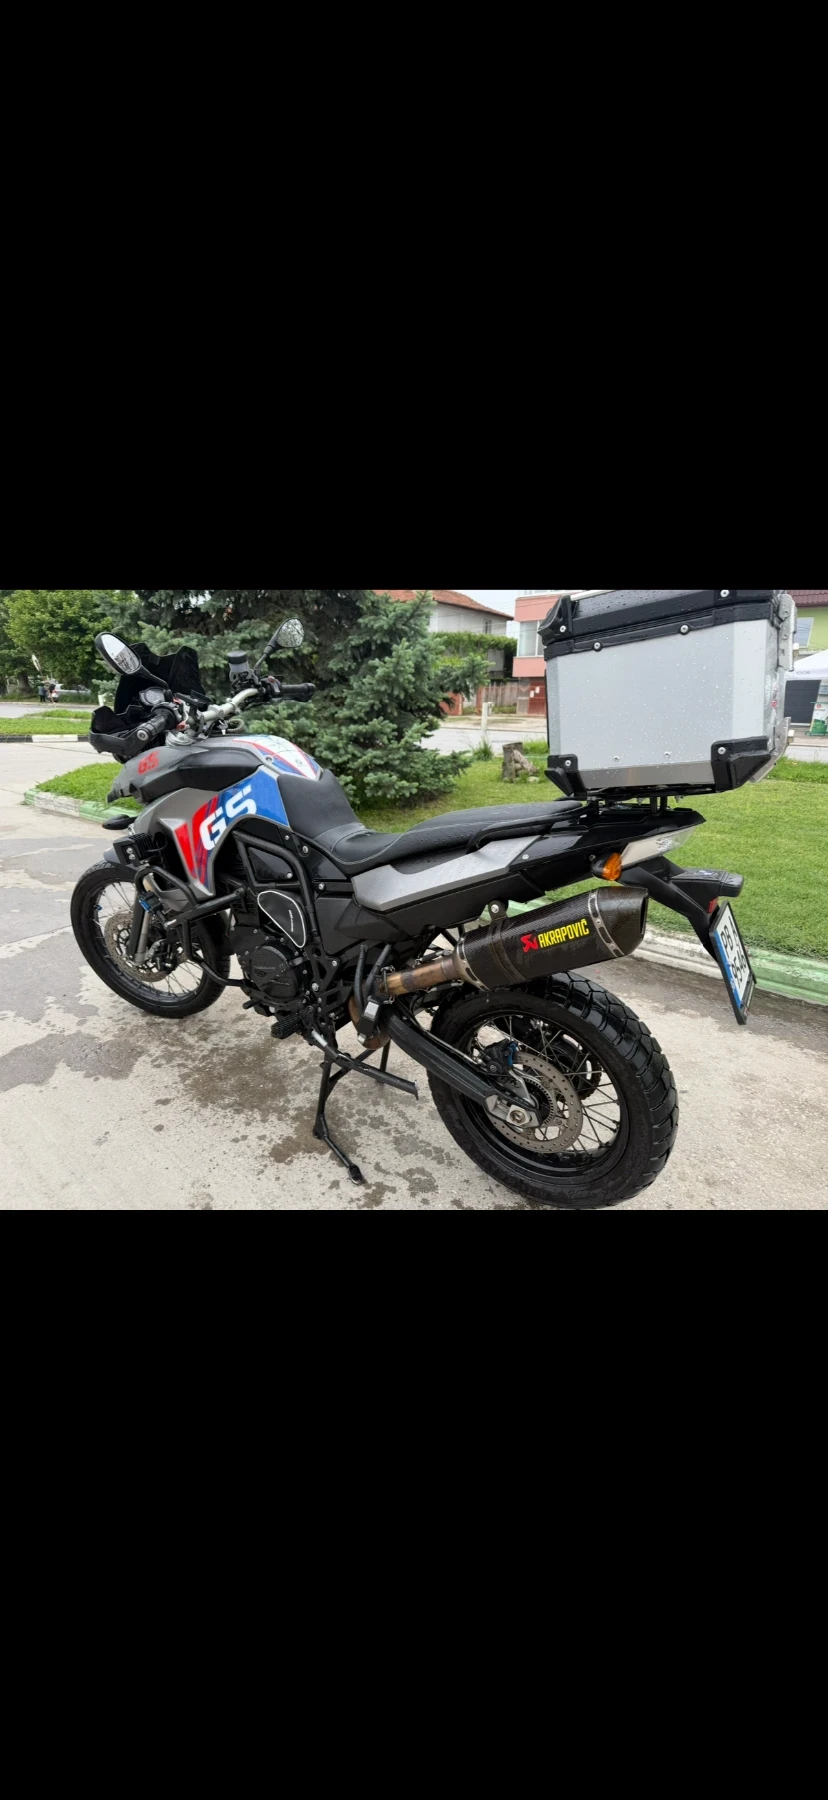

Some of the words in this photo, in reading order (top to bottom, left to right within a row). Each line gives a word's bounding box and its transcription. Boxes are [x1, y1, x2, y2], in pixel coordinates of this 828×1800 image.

[137, 751, 159, 775] GS
[199, 784, 257, 851] GS
[538, 918, 590, 949] AKRAPOVIČ
[720, 924, 734, 960] PB
